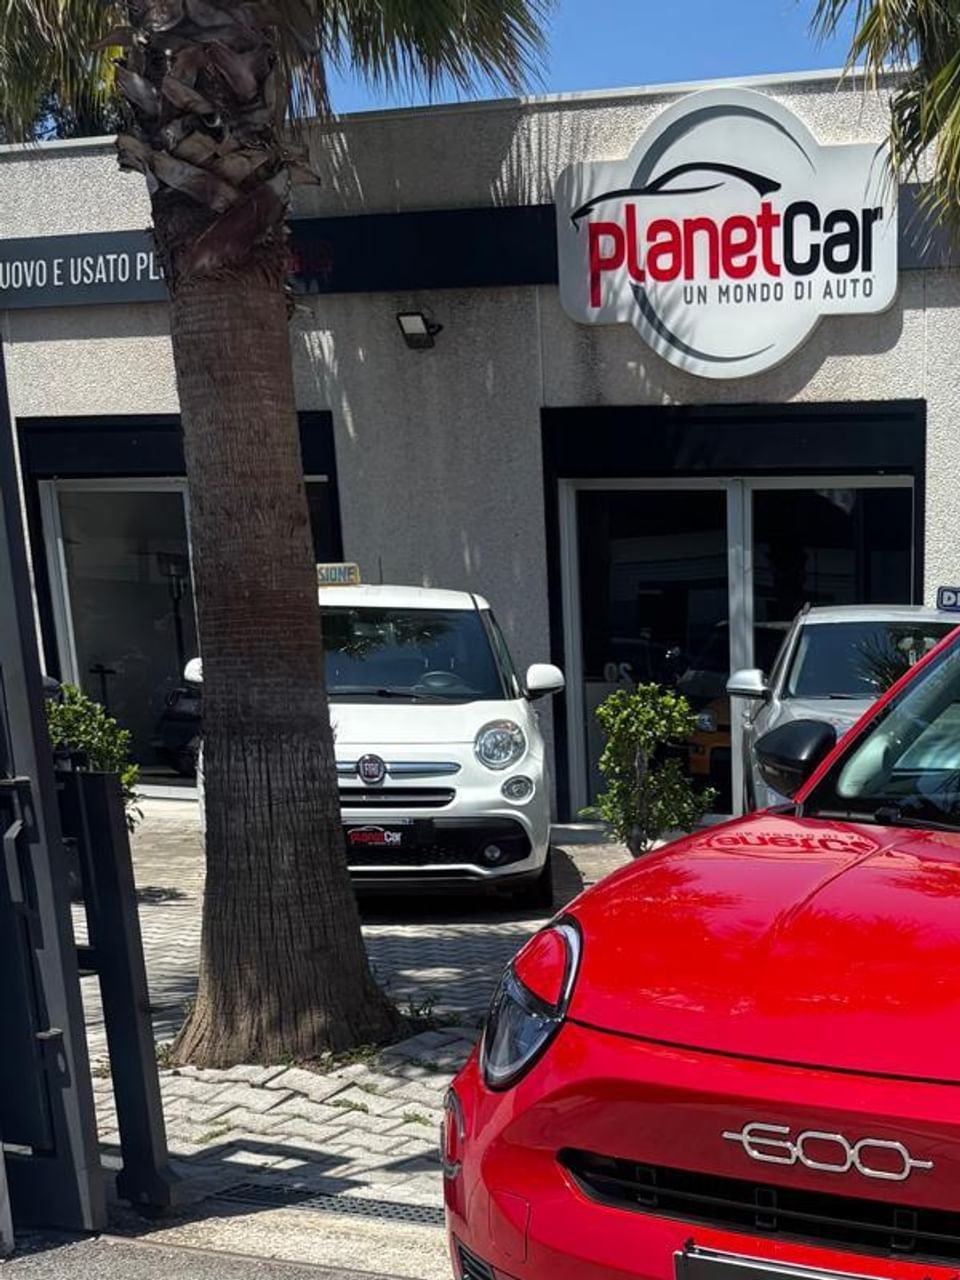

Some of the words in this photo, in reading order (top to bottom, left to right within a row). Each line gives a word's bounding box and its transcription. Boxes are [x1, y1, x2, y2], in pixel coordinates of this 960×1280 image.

[53, 258, 65, 286] E
[70, 252, 130, 285] USATO
[588, 200, 884, 308] planetCar
[683, 285, 707, 305] UN
[718, 282, 784, 304] MONDO
[794, 280, 812, 300] DI
[823, 277, 874, 299] AUTO
[722, 1122, 934, 1181] 600
